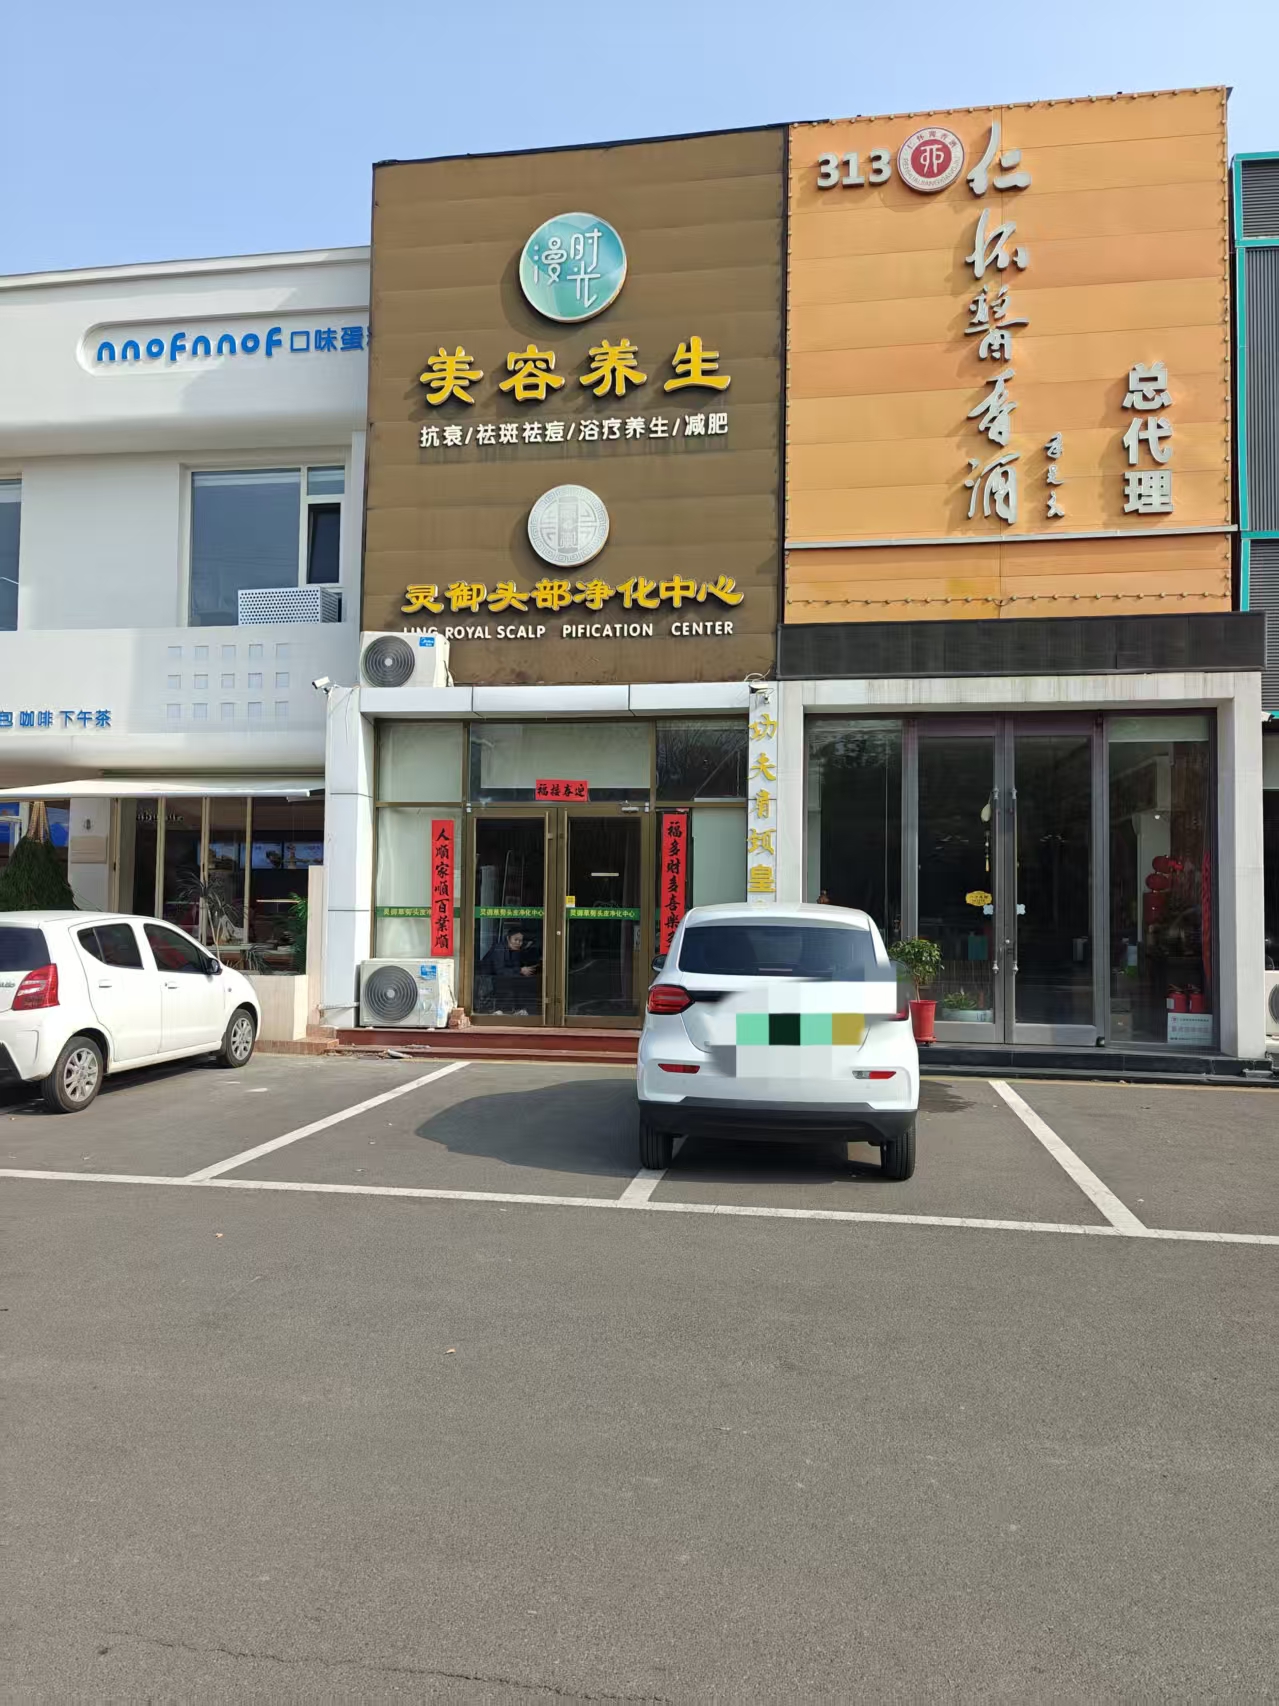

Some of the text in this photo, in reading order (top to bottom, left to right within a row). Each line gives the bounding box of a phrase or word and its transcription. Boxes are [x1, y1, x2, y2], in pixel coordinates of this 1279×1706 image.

[817, 148, 892, 189] 313
[291, 326, 369, 352] 口味蛋
[419, 335, 731, 406] 美容养生
[1122, 362, 1174, 514] 总代理
[400, 574, 744, 613] 灵御头部净化中心
[445, 626, 492, 639] ROYAL
[497, 625, 546, 639] SCALP
[562, 623, 654, 638] PIFICATION
[671, 621, 734, 637] CENTER
[20, 710, 53, 727] 咖啡
[59, 709, 112, 728] 下午茶
[747, 713, 778, 904] 功夫肩颈皇
